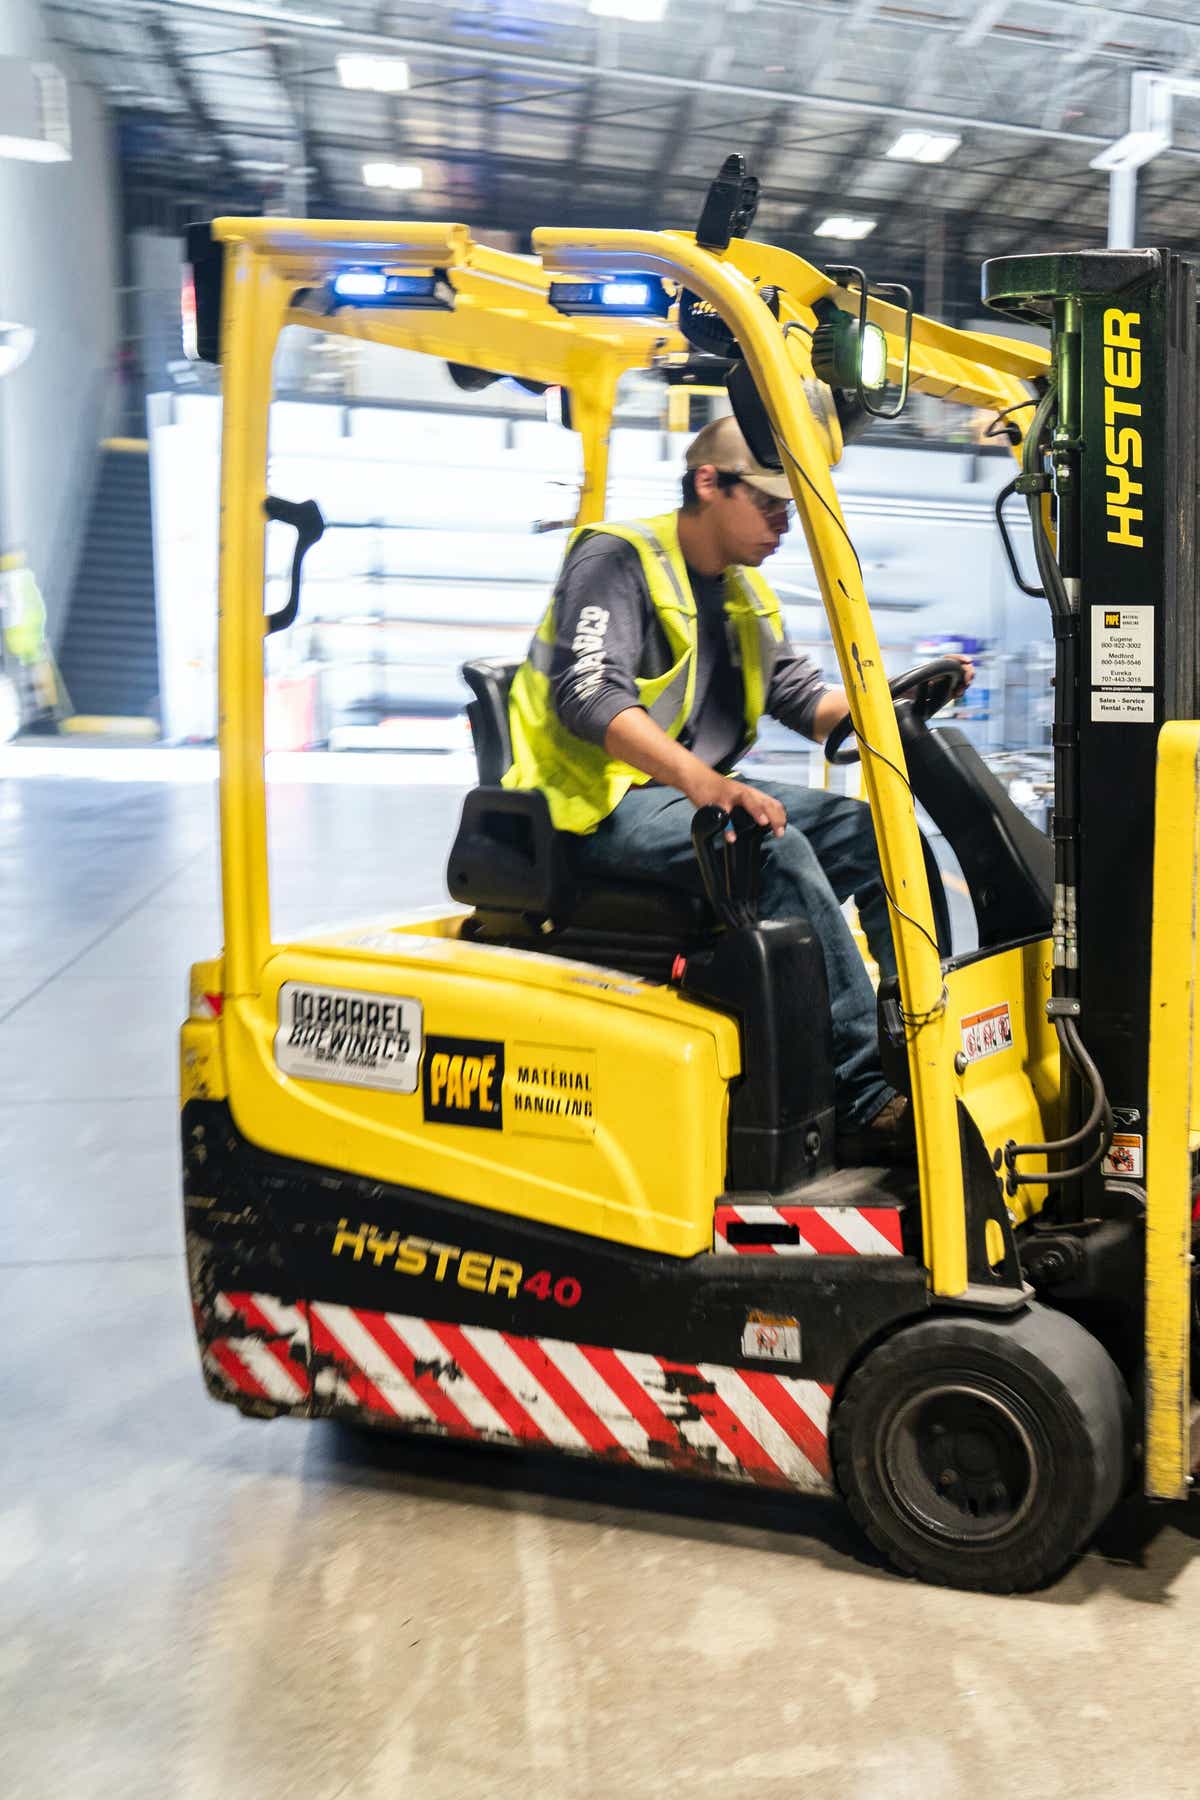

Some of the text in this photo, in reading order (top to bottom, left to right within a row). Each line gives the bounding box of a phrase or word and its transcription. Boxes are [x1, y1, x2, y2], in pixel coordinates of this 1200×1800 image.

[1104, 307, 1144, 549] HYSTER
[514, 1093, 592, 1117] HANDLING
[518, 1066, 592, 1092] MATERIAL
[332, 1218, 582, 1307] HYSTER 40
